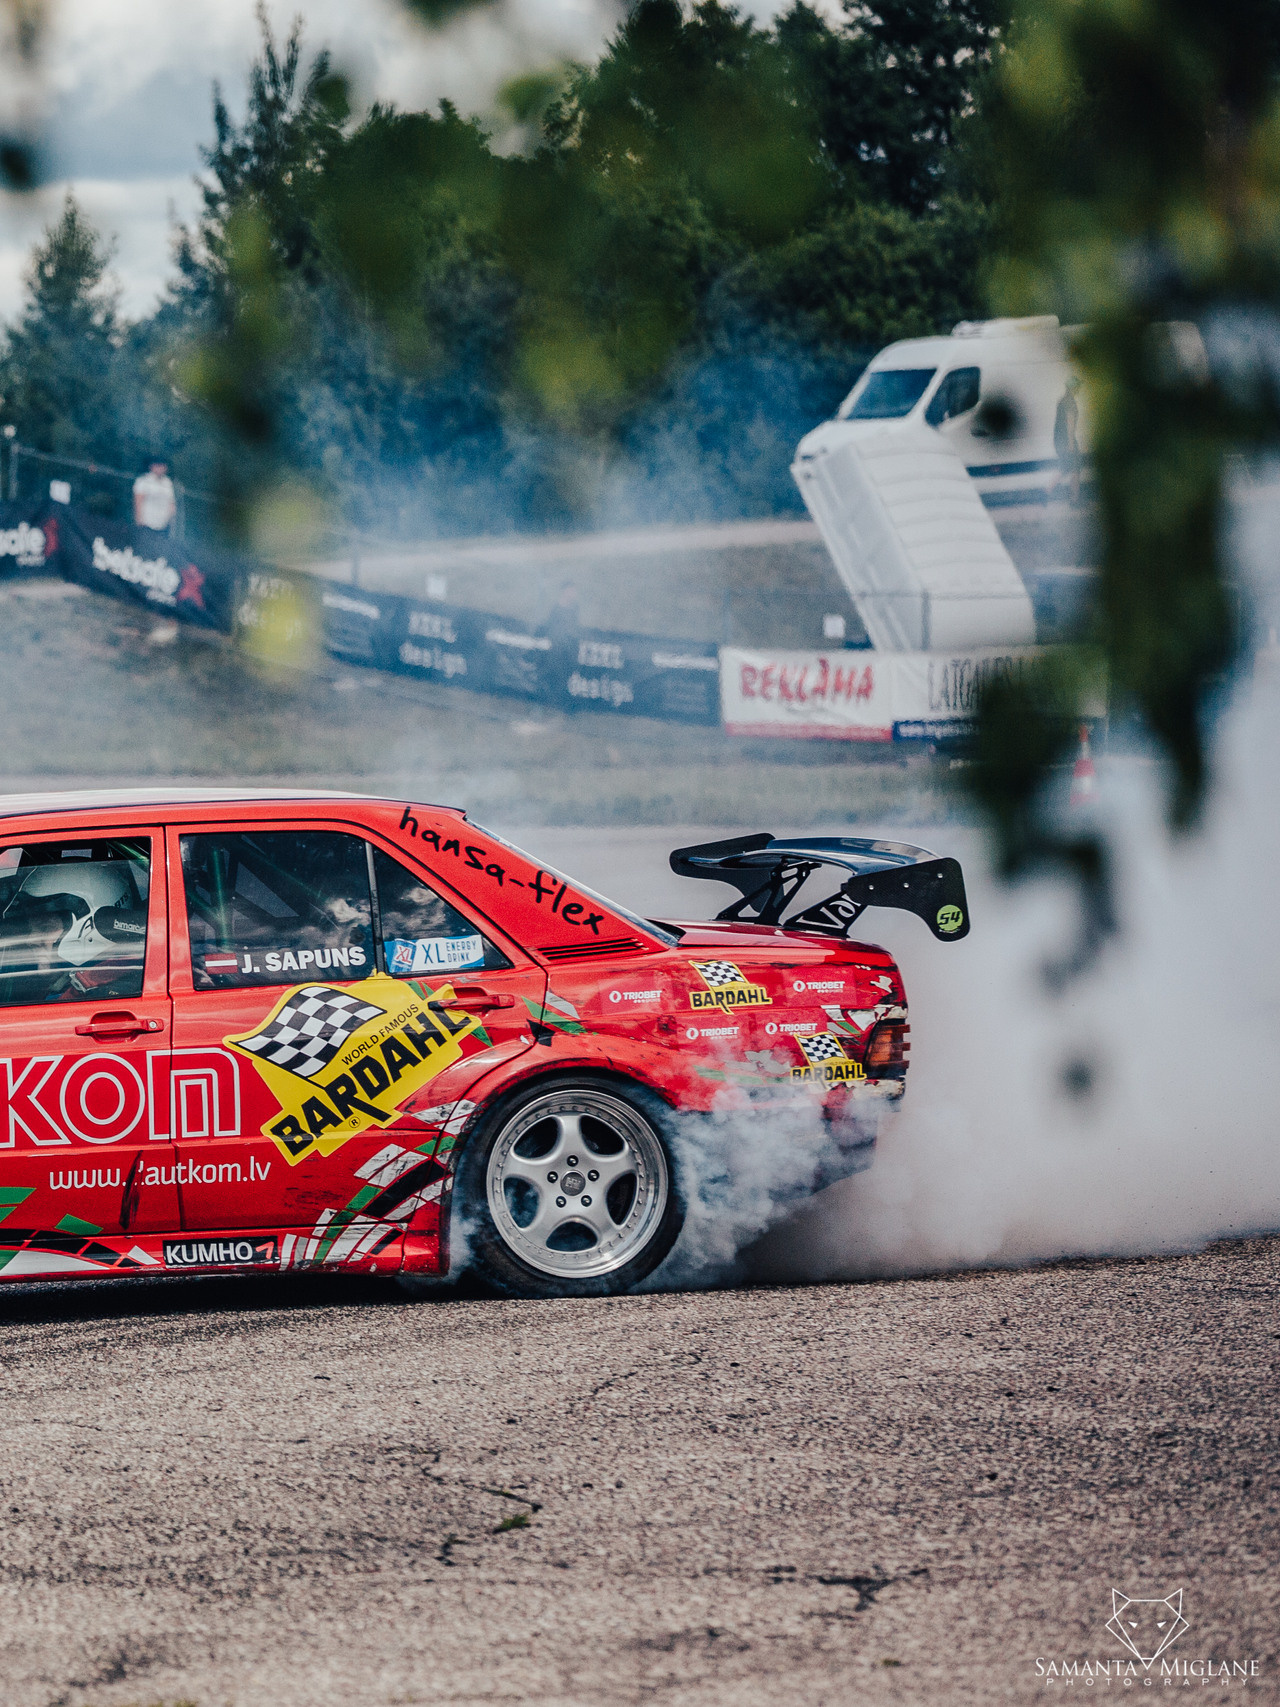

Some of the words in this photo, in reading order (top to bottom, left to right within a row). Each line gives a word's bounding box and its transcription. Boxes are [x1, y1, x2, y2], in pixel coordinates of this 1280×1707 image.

[399, 806, 605, 935] hansa-flex
[241, 954, 261, 974] J.
[265, 946, 367, 972] SAPUNS
[421, 943, 445, 964] XL
[623, 990, 663, 1000] TRIOBET
[806, 980, 846, 990] TRIOBET
[692, 988, 772, 1010] BARDAHL
[342, 1034, 380, 1066] WORLD
[379, 1003, 420, 1038] FAMOUS
[700, 1026, 740, 1036] TRIOBET
[778, 1022, 818, 1032] TRIOBET
[270, 1008, 472, 1156] BARDAHL
[792, 1064, 866, 1086] BARDAHL
[49, 1156, 271, 1190] www.autkom.lv
[166, 1241, 253, 1264] KUMHO
